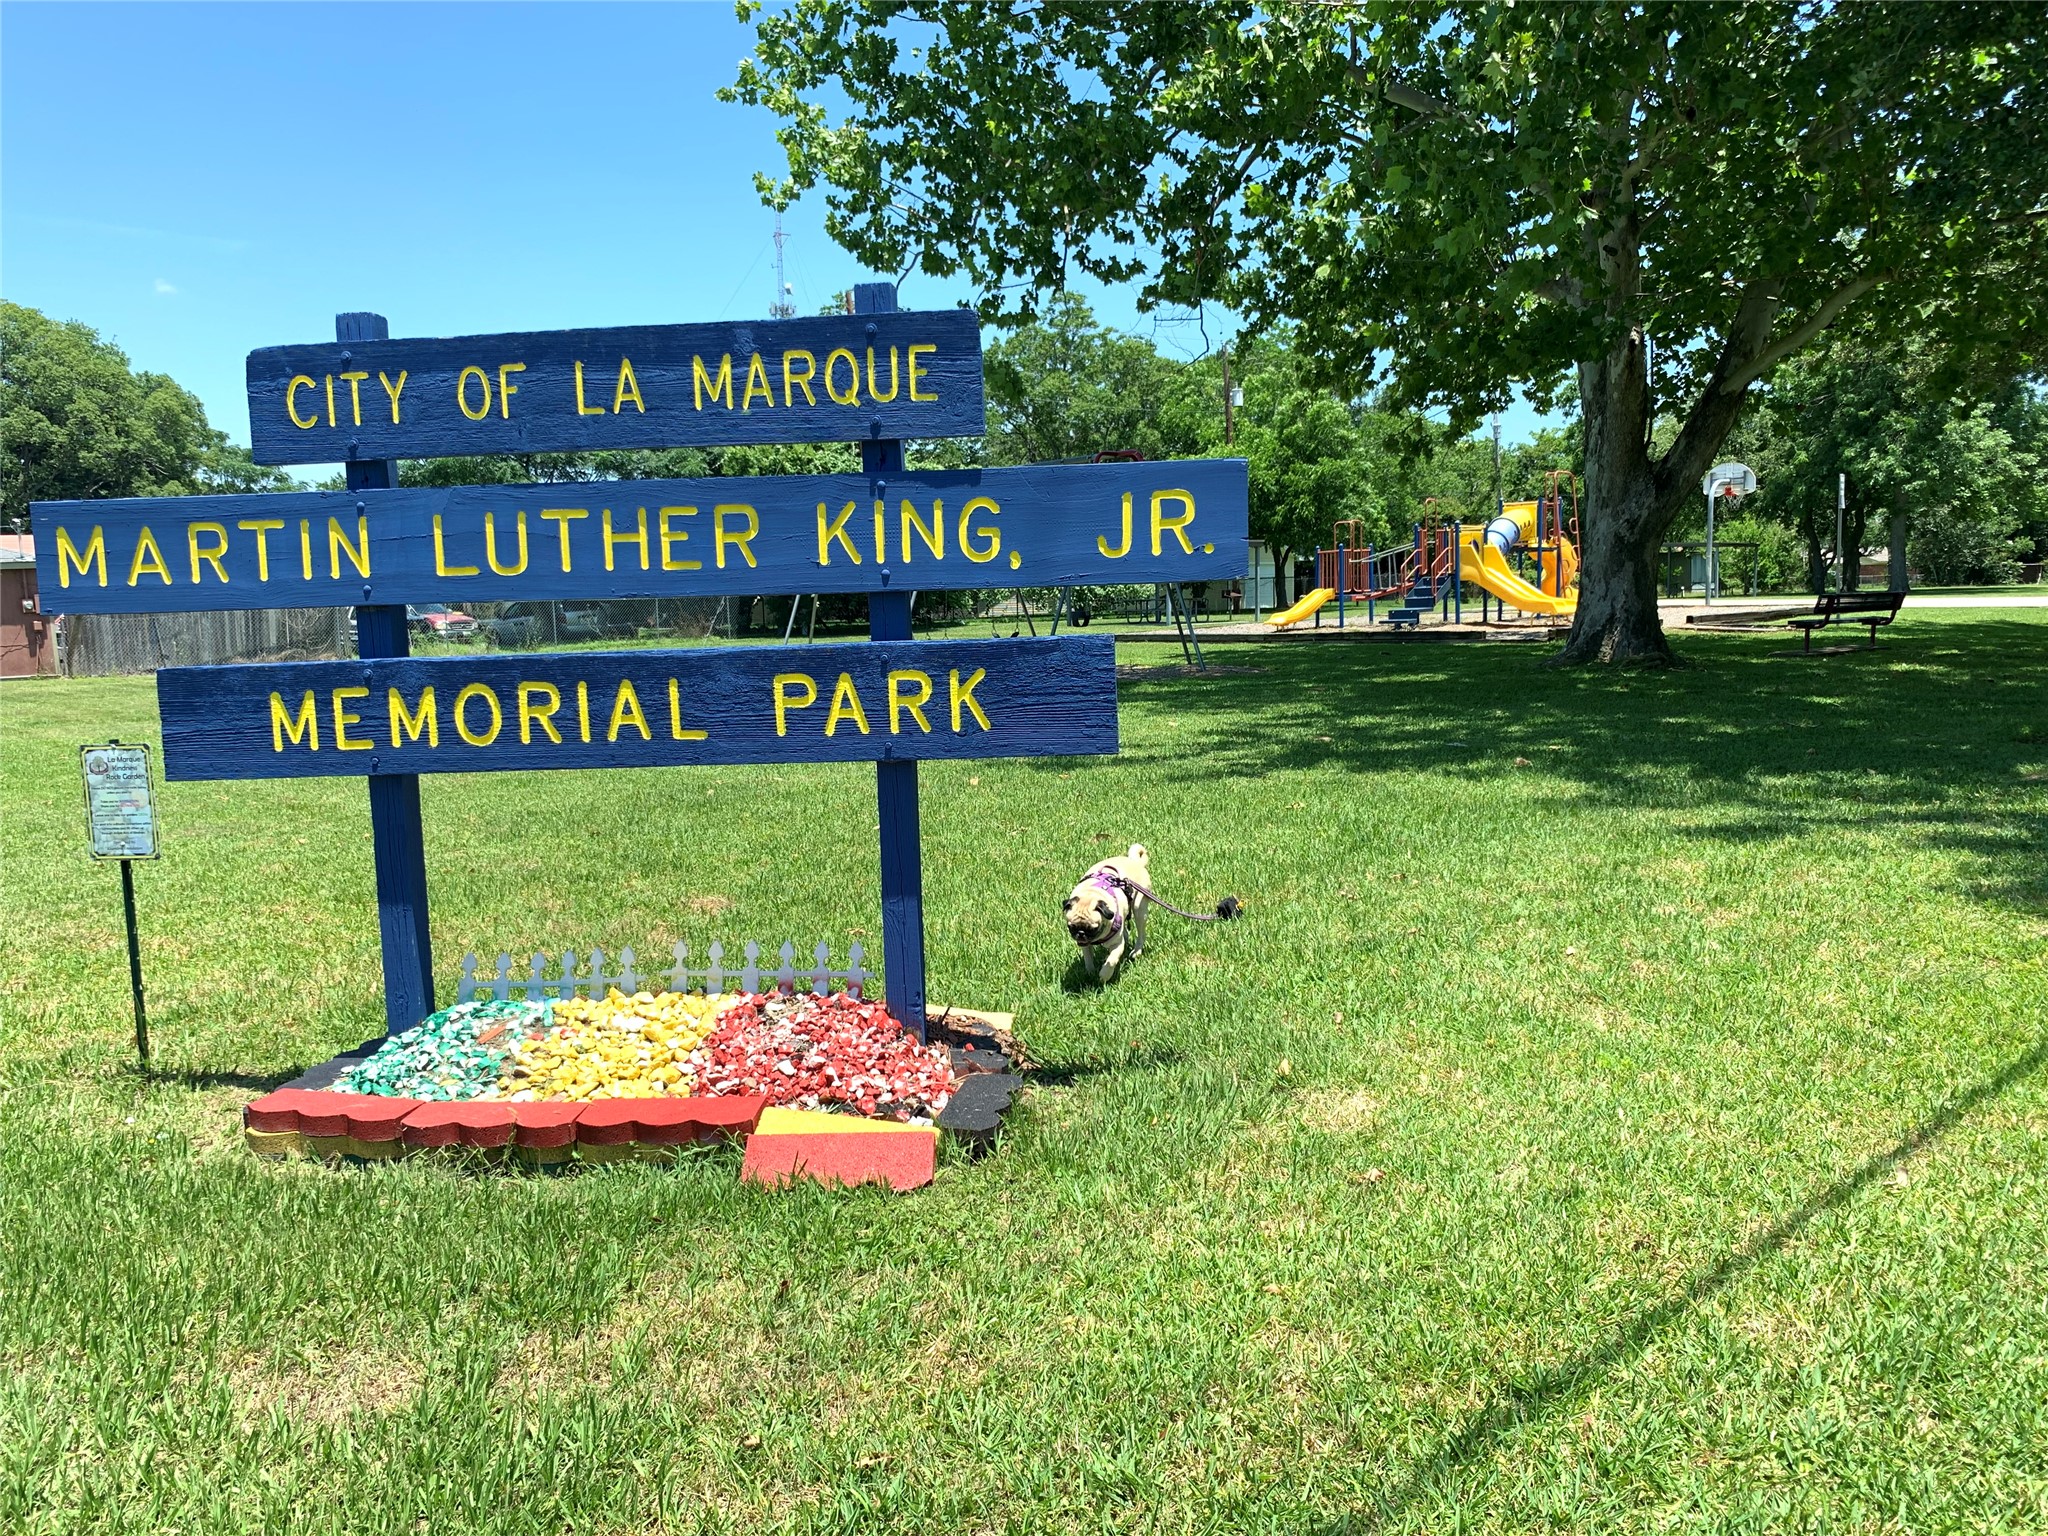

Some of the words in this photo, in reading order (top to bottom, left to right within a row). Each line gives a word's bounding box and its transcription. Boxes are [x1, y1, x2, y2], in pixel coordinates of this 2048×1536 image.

[288, 369, 408, 429] CITY
[457, 362, 526, 420] OF
[575, 359, 646, 416] LA
[692, 344, 939, 409] MARQUE
[56, 517, 372, 588] MARTIN
[433, 504, 760, 577] LUTHER
[817, 497, 1022, 570] KING,
[1097, 489, 1215, 557] JR.
[269, 677, 709, 753] MEMORIAL
[773, 668, 993, 736] PARK
[117, 756, 141, 764] Marque
